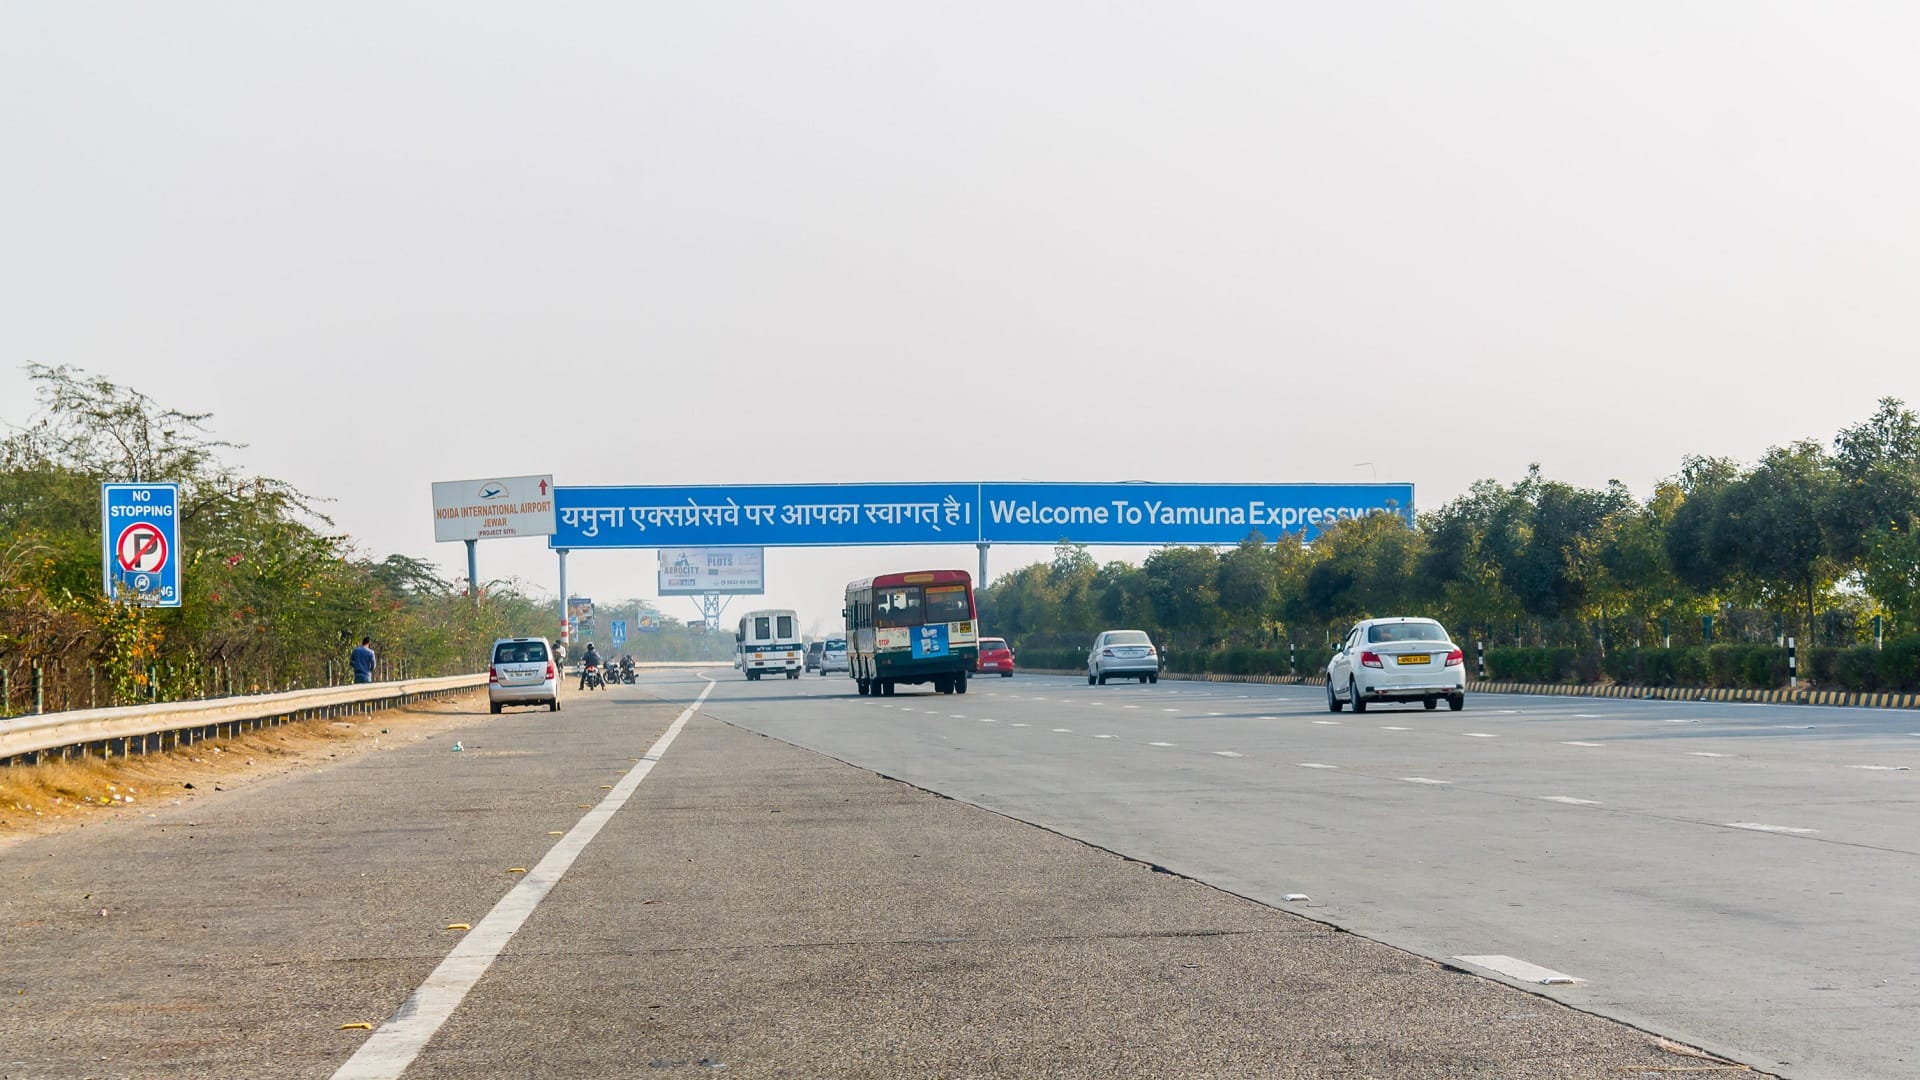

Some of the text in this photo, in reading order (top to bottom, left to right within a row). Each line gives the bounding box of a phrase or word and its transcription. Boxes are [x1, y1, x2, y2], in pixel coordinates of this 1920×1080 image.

[132, 490, 151, 501] NO
[111, 505, 173, 517] STOPPING
[436, 501, 552, 520] NOIDA INTERNATIONAL AIRPORT
[989, 500, 1109, 524] Welcome
[1111, 500, 1142, 524] To
[1143, 500, 1245, 525] Yamuna
[483, 517, 508, 528] JEWAR
[560, 507, 625, 537] यमुना
[629, 497, 740, 531] एक्सप्रेसवे
[744, 504, 776, 526] पर
[780, 503, 859, 526] आपका
[478, 529, 502, 537] (PROJECT
